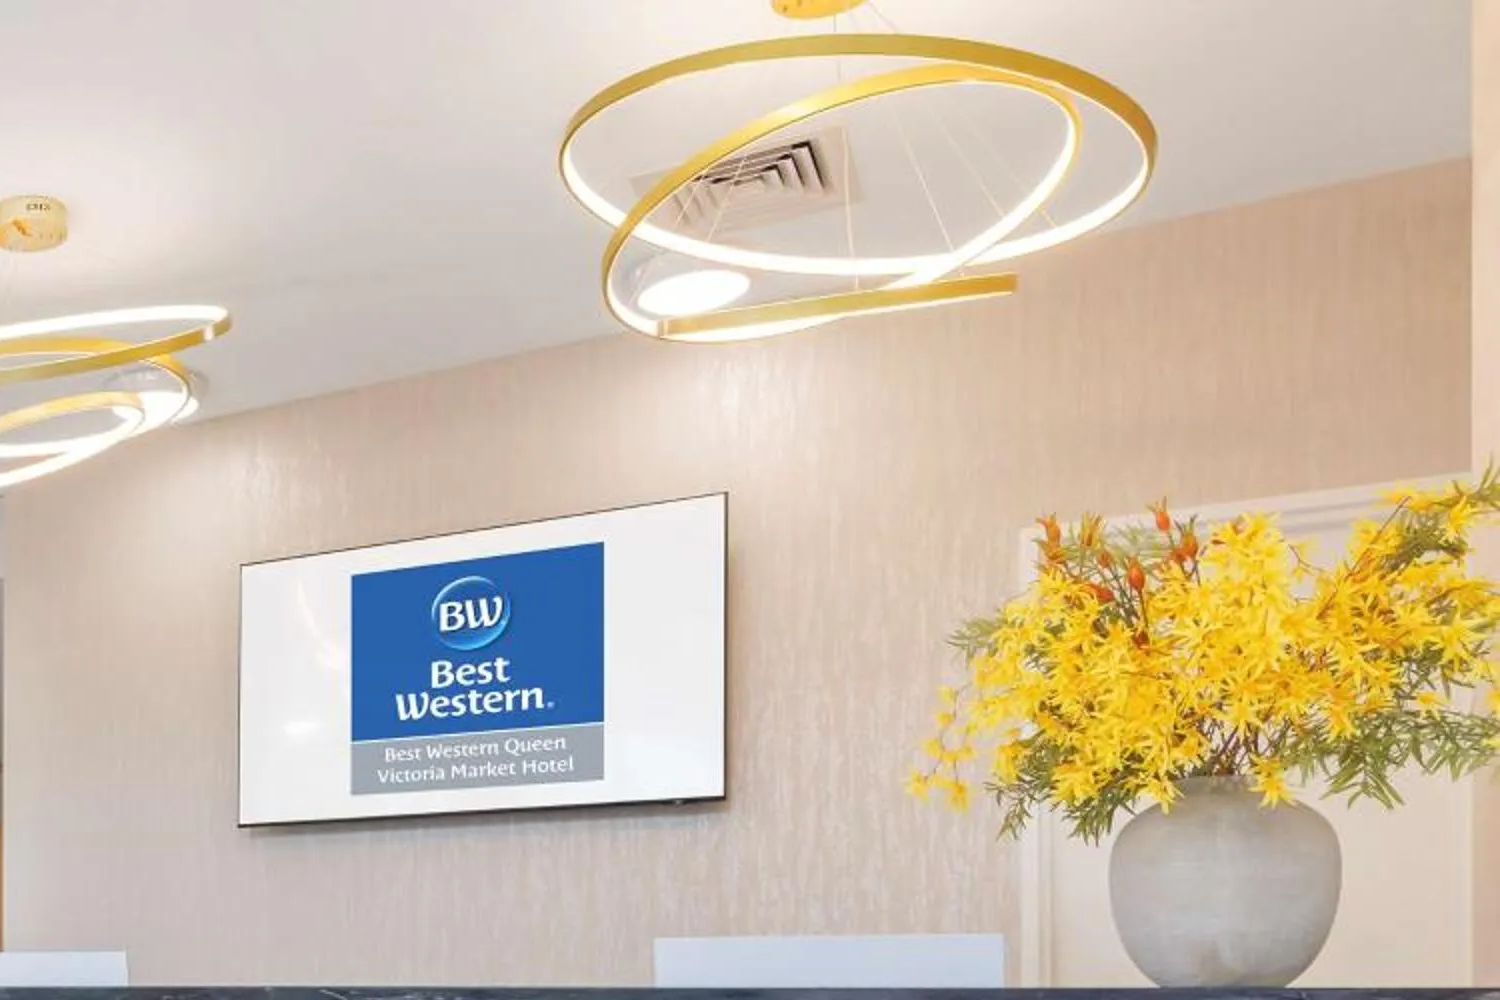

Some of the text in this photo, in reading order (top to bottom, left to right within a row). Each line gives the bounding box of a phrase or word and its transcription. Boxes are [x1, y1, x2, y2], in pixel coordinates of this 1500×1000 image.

[439, 595, 503, 632] BW
[430, 656, 511, 688] Best
[384, 736, 567, 762] Best Western Queen
[376, 755, 575, 783] Victoria Market Hotel
